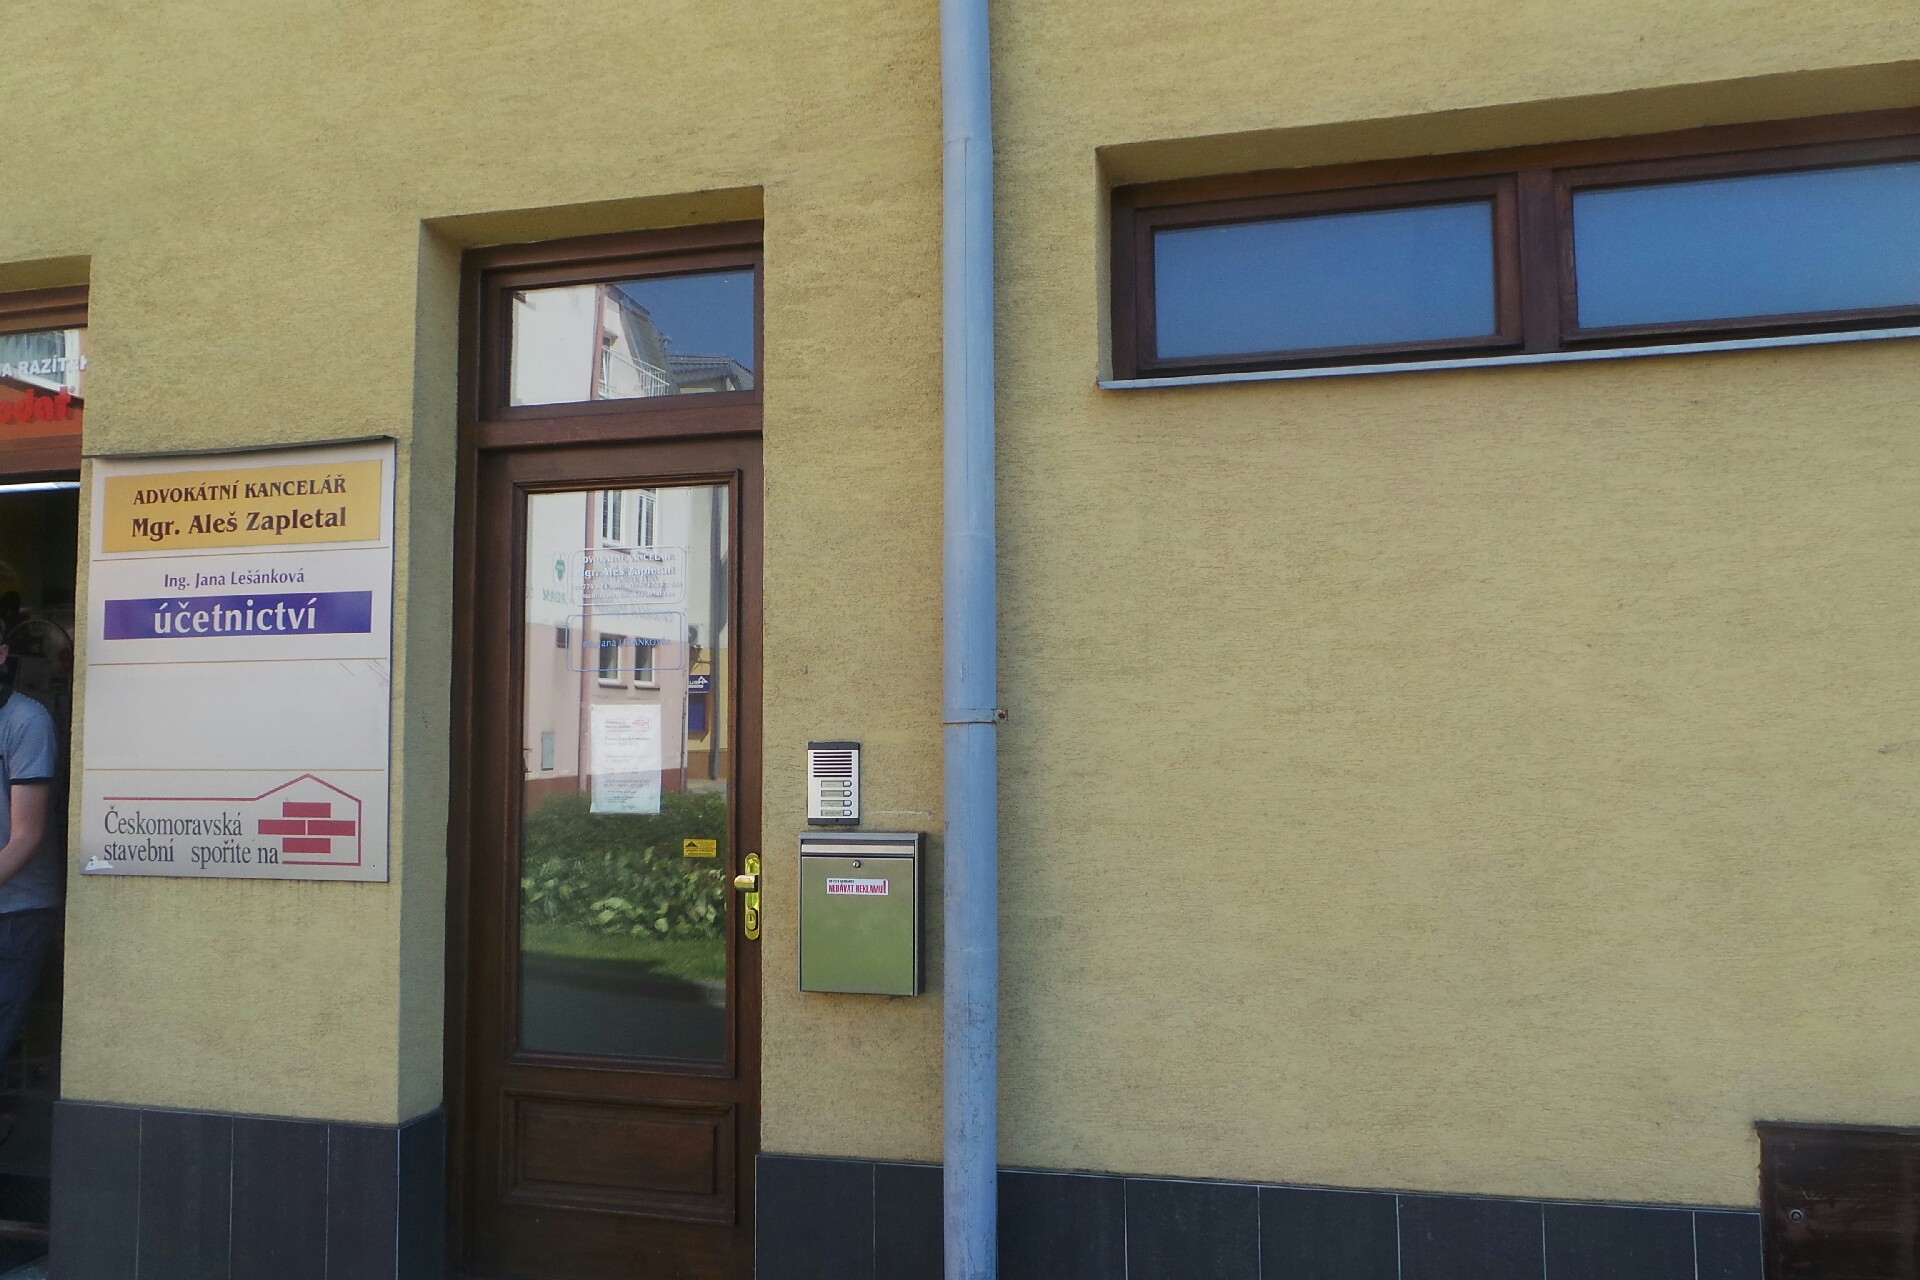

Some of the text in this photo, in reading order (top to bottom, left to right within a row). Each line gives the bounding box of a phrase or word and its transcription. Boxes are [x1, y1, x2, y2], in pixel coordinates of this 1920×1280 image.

[133, 474, 347, 505] ADVOKÁTNÍ KANCELÁŘ
[131, 507, 347, 541] Mgr. Aleš Zapletal
[164, 568, 305, 590] Ing. Jana Lešánková
[153, 597, 318, 635] účetnictví
[104, 805, 243, 836] Českomoravská
[103, 838, 174, 863] stavební
[828, 883, 854, 893] NEDÁVAT
